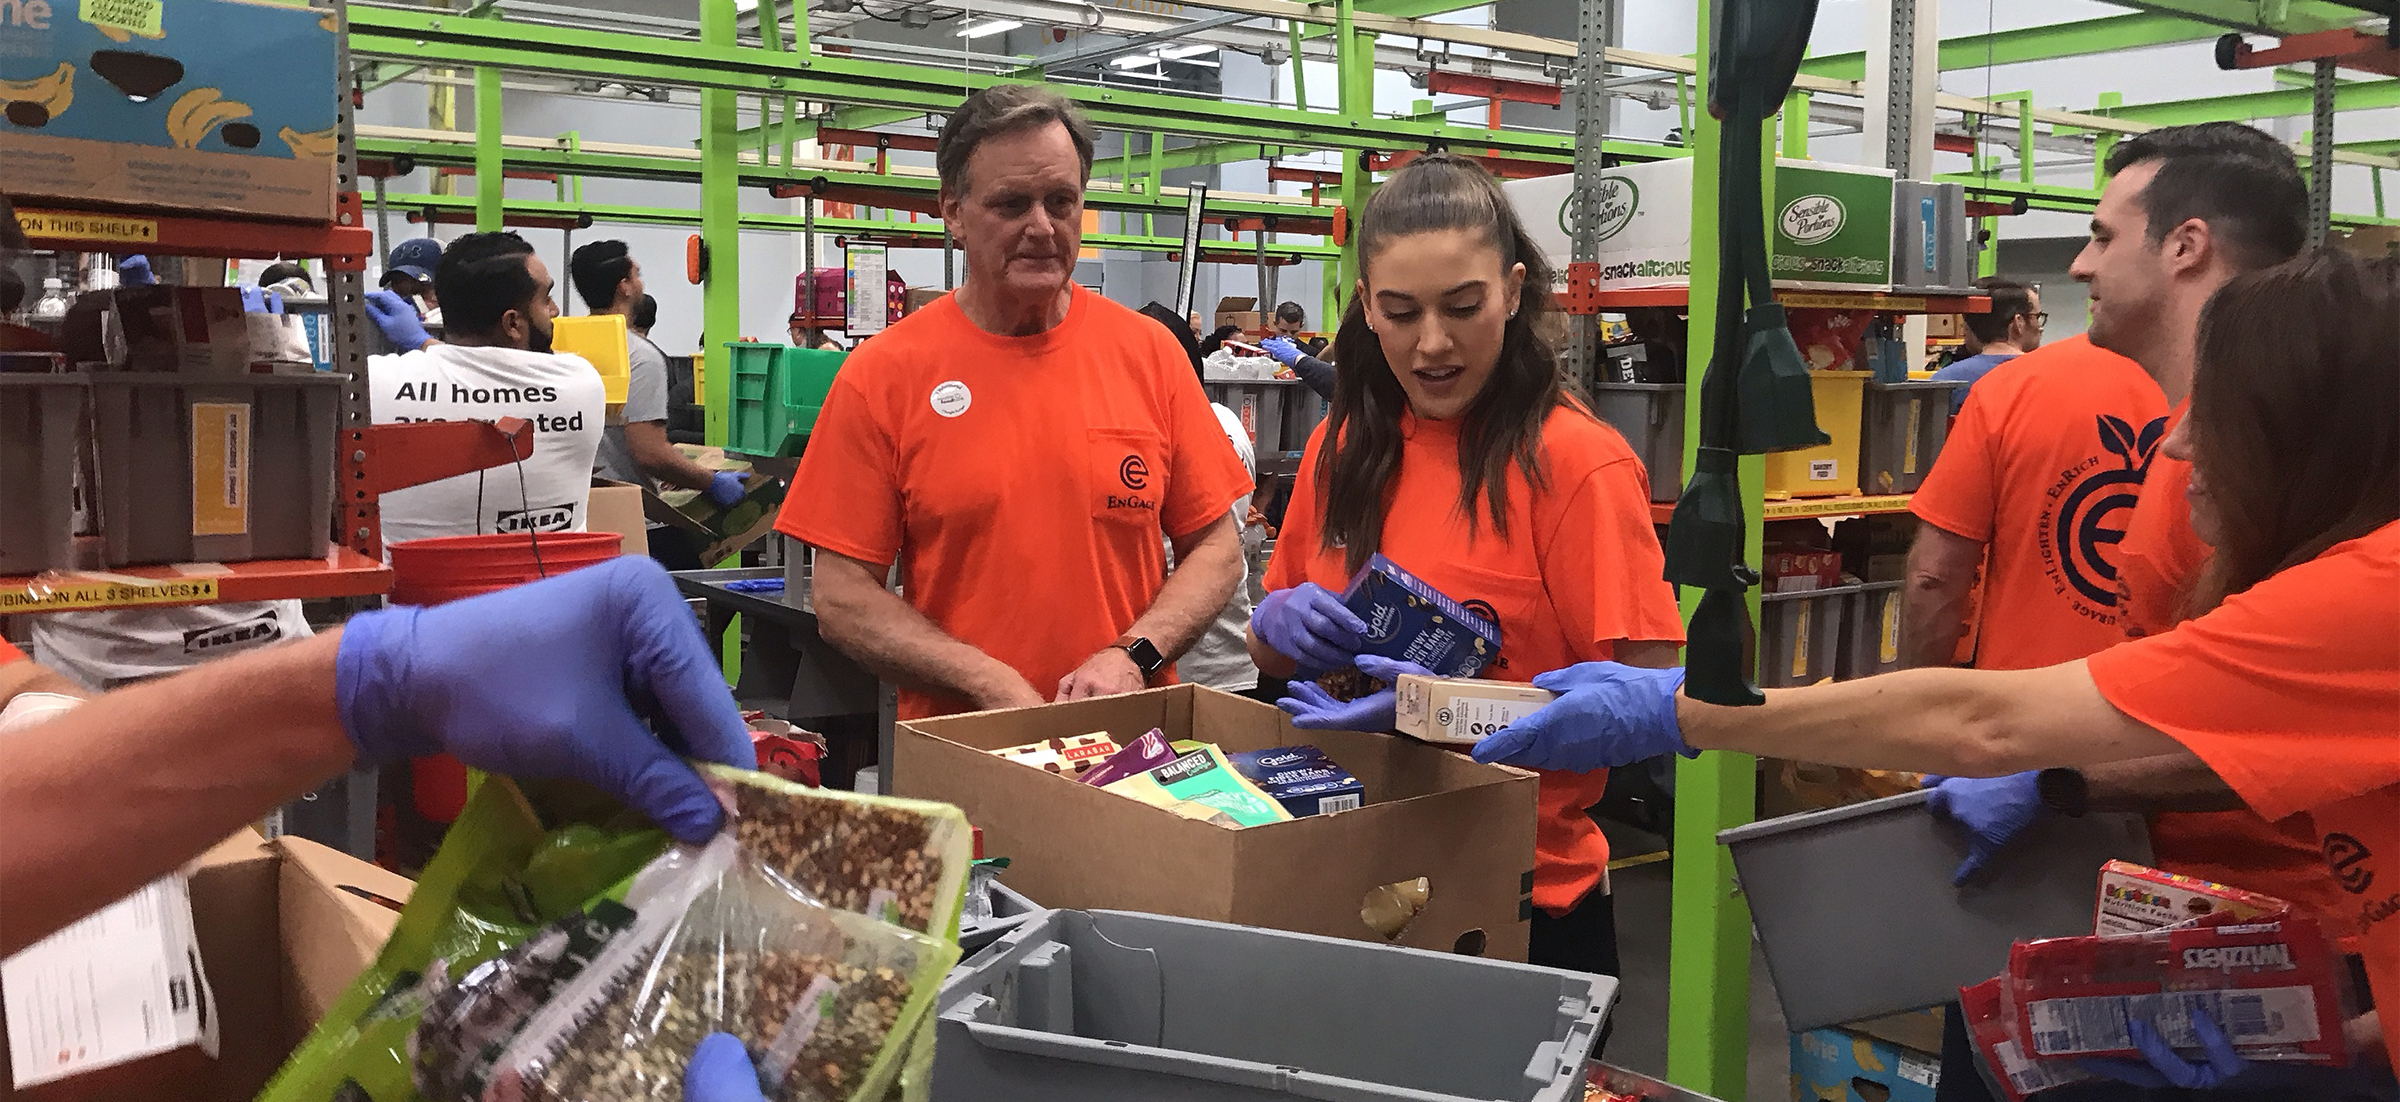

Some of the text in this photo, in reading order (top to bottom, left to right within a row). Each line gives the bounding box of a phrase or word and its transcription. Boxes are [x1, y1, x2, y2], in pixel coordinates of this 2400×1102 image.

[1789, 200, 1830, 222] Sensible
[19, 218, 139, 235] ON THIS SHELF
[1796, 216, 1836, 236] Portions
[1772, 253, 1806, 271] cious
[394, 382, 558, 404] All homes
[508, 511, 567, 531] IKEA
[74, 590, 100, 603] ALL
[106, 589, 116, 601] 3
[119, 584, 189, 599] SHELVES
[1402, 629, 1430, 660] CHEWY
[1066, 744, 1112, 762] LARABAR
[1160, 754, 1208, 779] BALANCED
